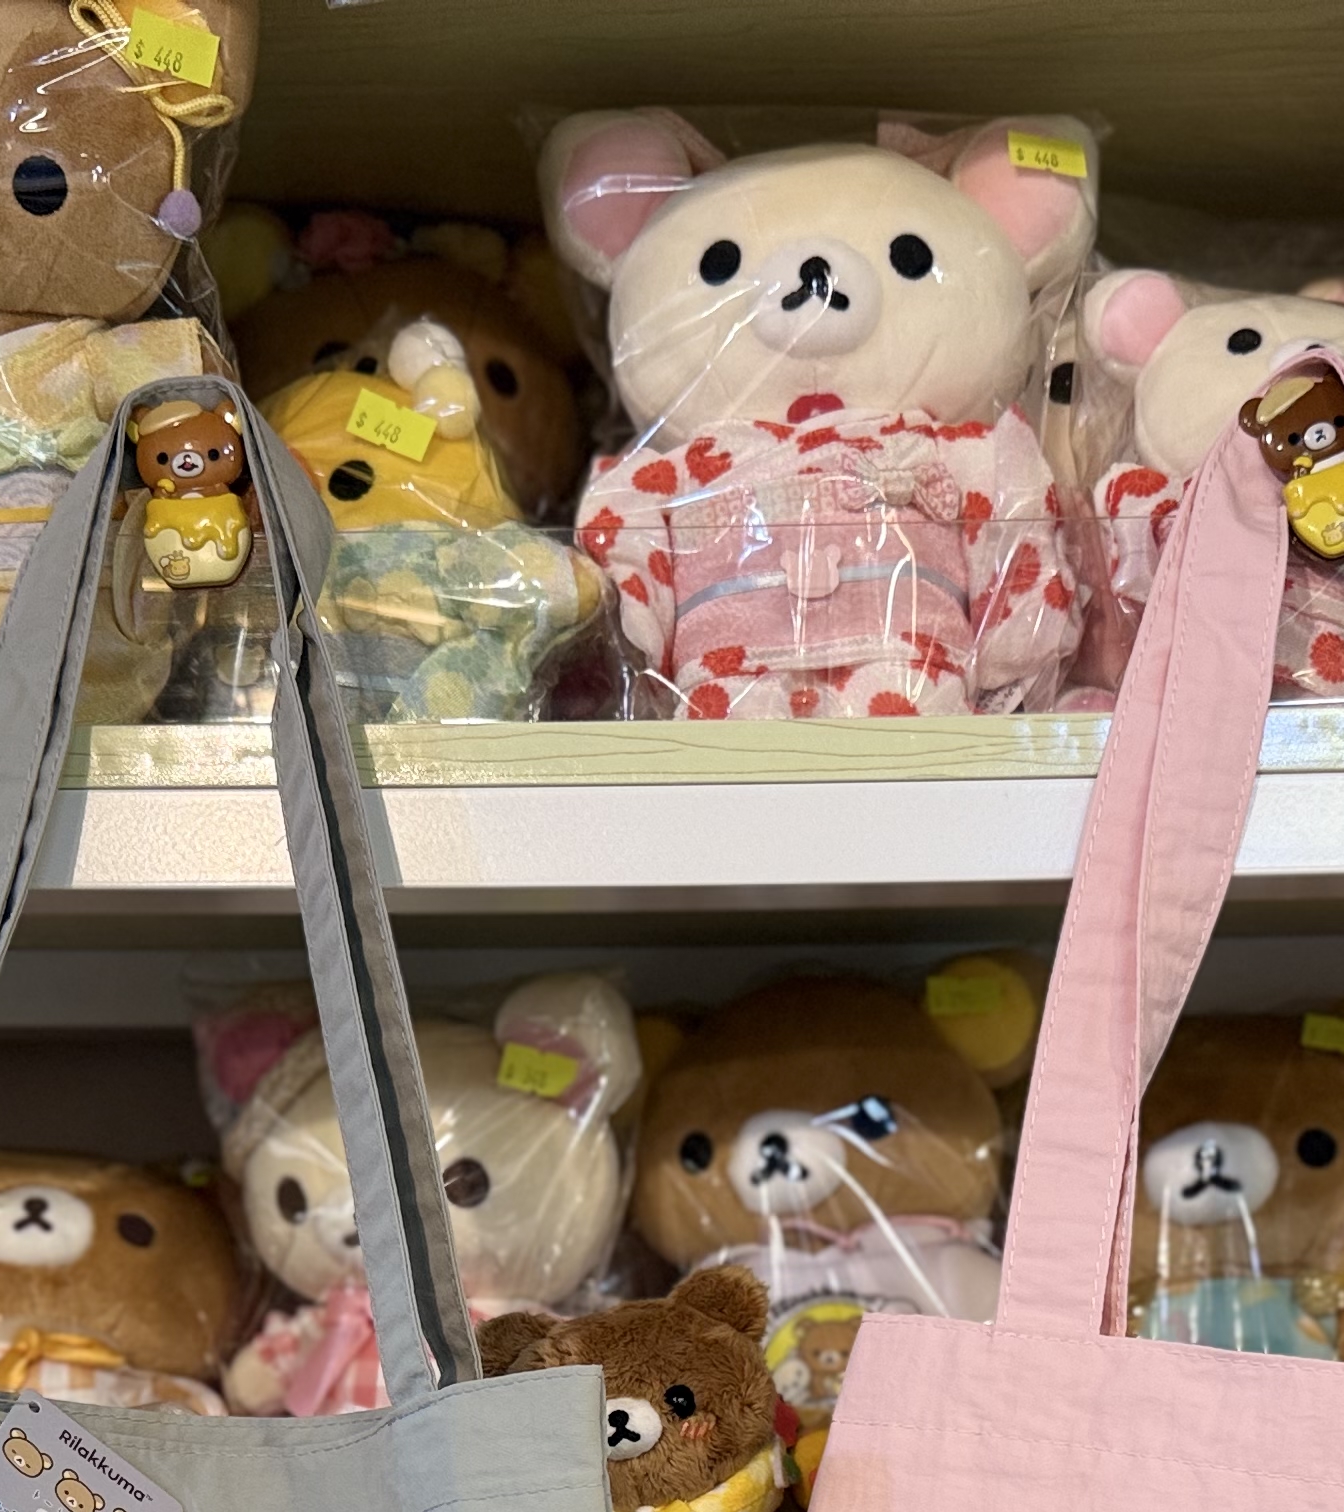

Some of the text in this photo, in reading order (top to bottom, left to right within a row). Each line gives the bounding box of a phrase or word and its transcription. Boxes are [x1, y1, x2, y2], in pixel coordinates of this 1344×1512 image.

[154, 46, 183, 72] 448
[1035, 150, 1059, 168] 448
[356, 412, 401, 444] $ 448
